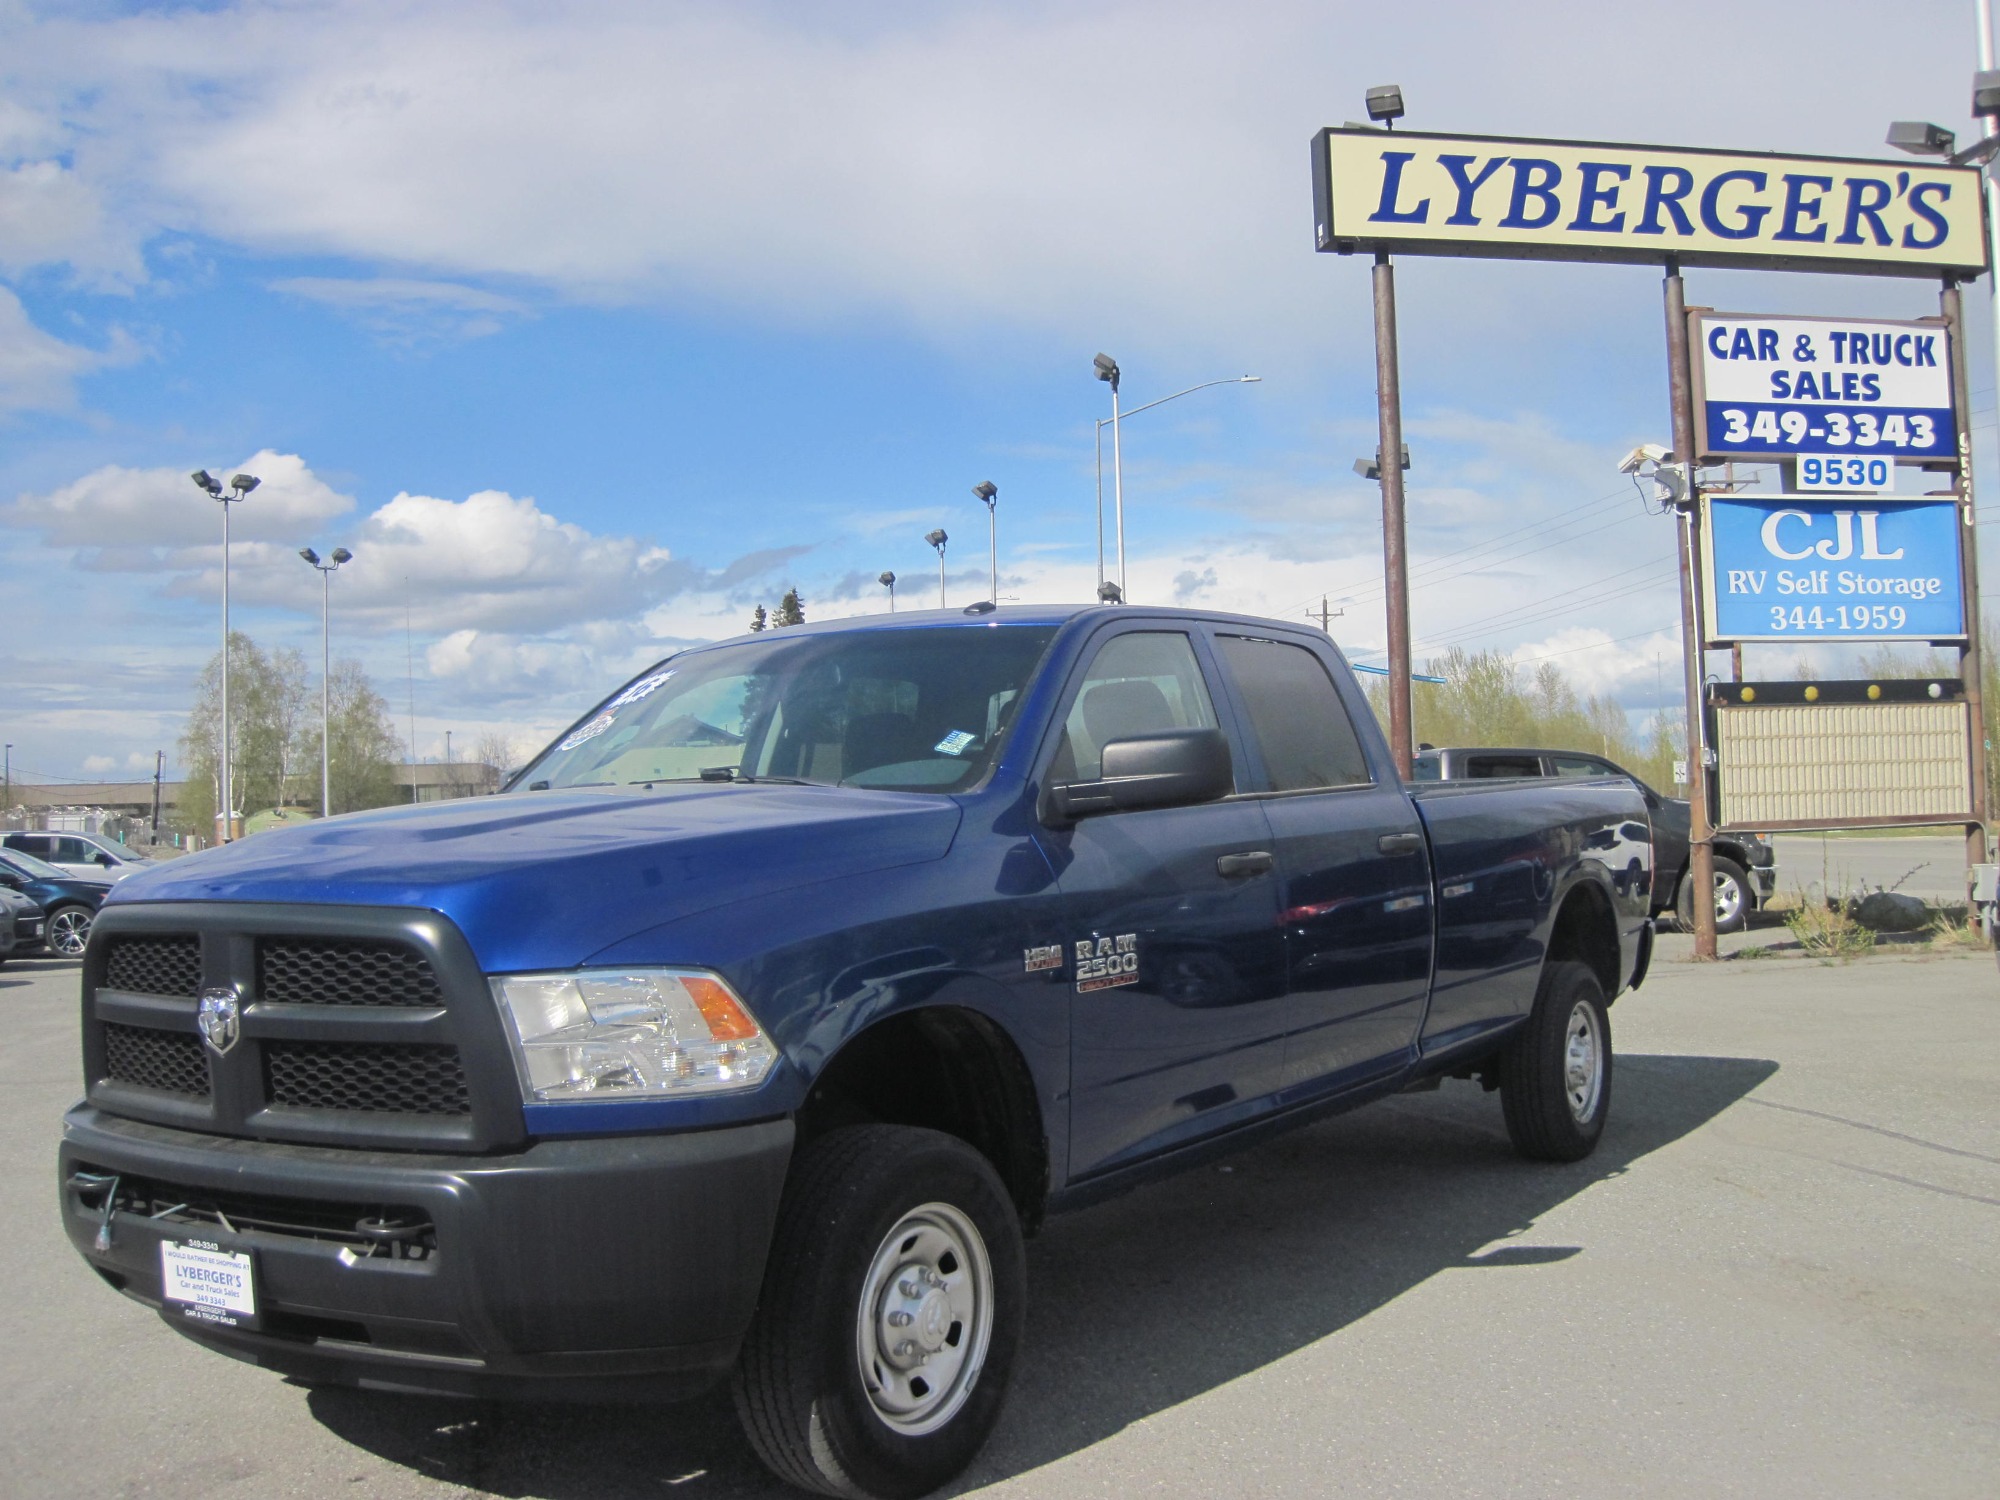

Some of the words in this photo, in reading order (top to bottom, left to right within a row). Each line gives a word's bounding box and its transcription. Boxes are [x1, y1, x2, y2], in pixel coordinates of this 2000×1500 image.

[1367, 151, 1952, 251] LYBERGER'S
[1708, 326, 1780, 362] CAR
[1793, 334, 1817, 363] &
[1829, 331, 1937, 367] TRUCK
[1770, 369, 1882, 402] SALES
[1722, 409, 1935, 448] 349-3343
[1803, 458, 1887, 486] 9530
[1760, 508, 1904, 561] CJL
[1728, 570, 1767, 595] RV
[1776, 570, 1829, 595] Self
[1837, 570, 1941, 599] Storage
[1770, 605, 1906, 630] 344-1959
[1024, 944, 1062, 961] HEMI
[1076, 934, 1136, 960] RAM
[1076, 952, 1138, 981] 2500
[188, 1239, 218, 1251] 349-3343
[168, 1250, 186, 1260] WOULD
[187, 1253, 208, 1263] RATHER
[216, 1258, 242, 1269] SHOPPING
[242, 1263, 250, 1271] AT
[176, 1265, 242, 1287] LYBERGER'S
[180, 1280, 191, 1289] Car
[192, 1282, 204, 1291] and
[205, 1284, 223, 1295] Truck
[224, 1288, 240, 1298] Sales
[196, 1294, 209, 1303] 349
[209, 1296, 226, 1307] 3343
[185, 1309, 197, 1318] CAR
[202, 1312, 221, 1321] TRUCK
[221, 1315, 237, 1325] SALES
[195, 1304, 226, 1316] LYBERGER'S
